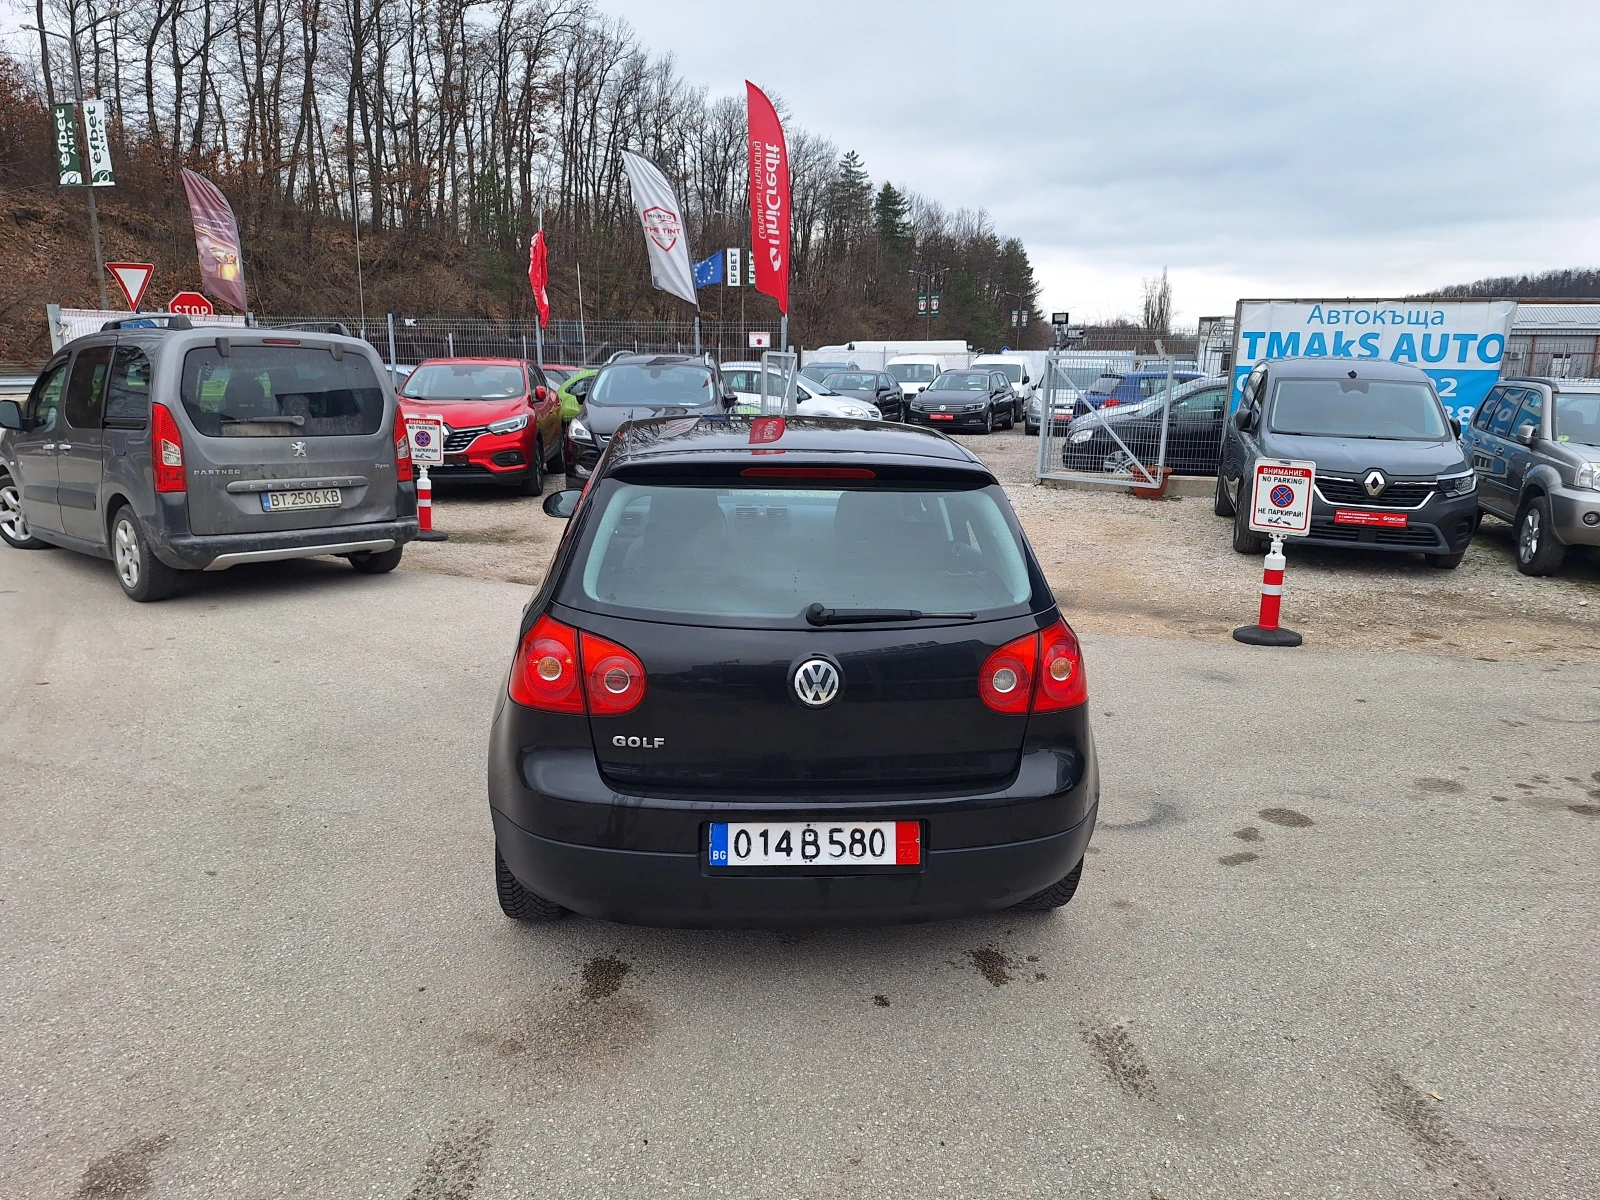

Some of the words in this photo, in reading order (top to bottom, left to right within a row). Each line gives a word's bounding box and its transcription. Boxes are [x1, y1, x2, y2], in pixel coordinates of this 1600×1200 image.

[55, 108, 70, 168] efbet
[86, 105, 102, 165] efbet
[644, 226, 660, 234] THE
[174, 304, 209, 315] STOP
[1306, 304, 1445, 329] Автокъща
[1390, 332, 1506, 364] AUTO
[1263, 467, 1306, 477] ВНИМАНИЕ!
[250, 480, 353, 490] PEUGEOT
[1274, 477, 1305, 485] PARKING!
[1268, 508, 1304, 518] ПАРКИРАЙ!
[612, 735, 665, 748] GOLF
[712, 850, 727, 860] BG
